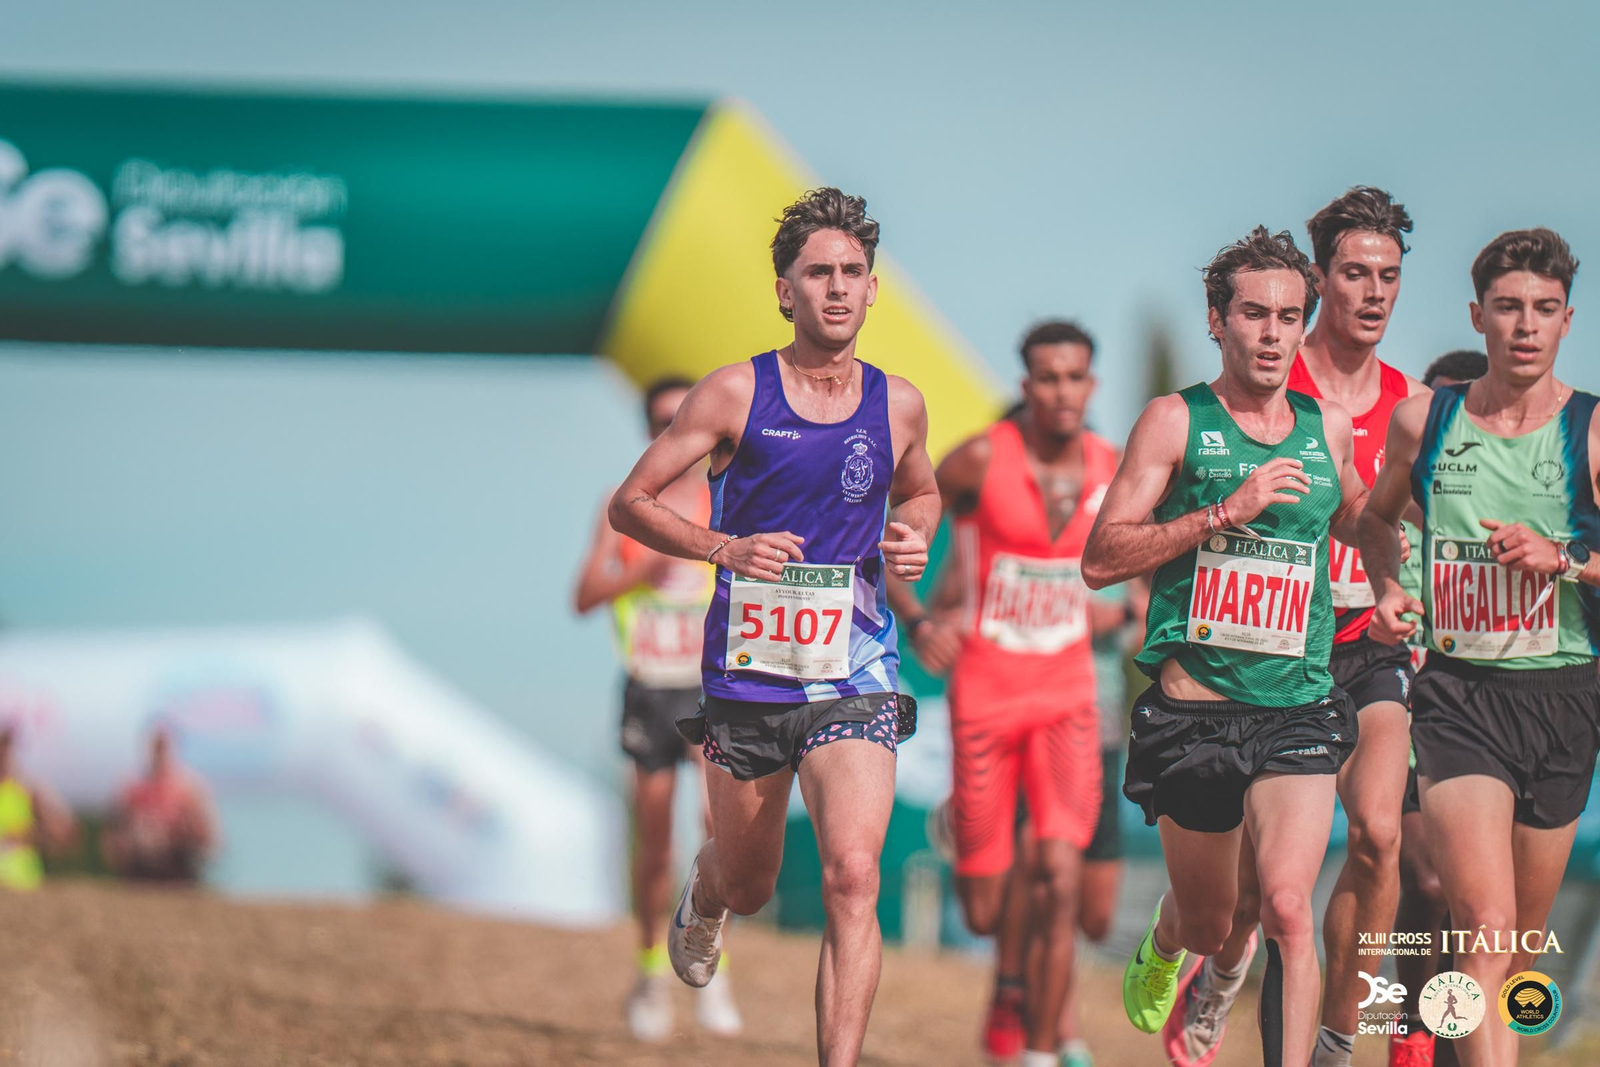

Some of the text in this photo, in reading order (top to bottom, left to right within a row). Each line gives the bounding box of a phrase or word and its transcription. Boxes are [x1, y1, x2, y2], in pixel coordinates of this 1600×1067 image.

[761, 428, 793, 439] CRAFT
[1198, 446, 1230, 456] rasán
[1437, 463, 1478, 472] UCLM
[1235, 540, 1288, 559] ITÁLICA
[781, 567, 824, 584] ÁLICA
[1191, 565, 1310, 633] MARTÍN
[740, 602, 843, 646] 5107
